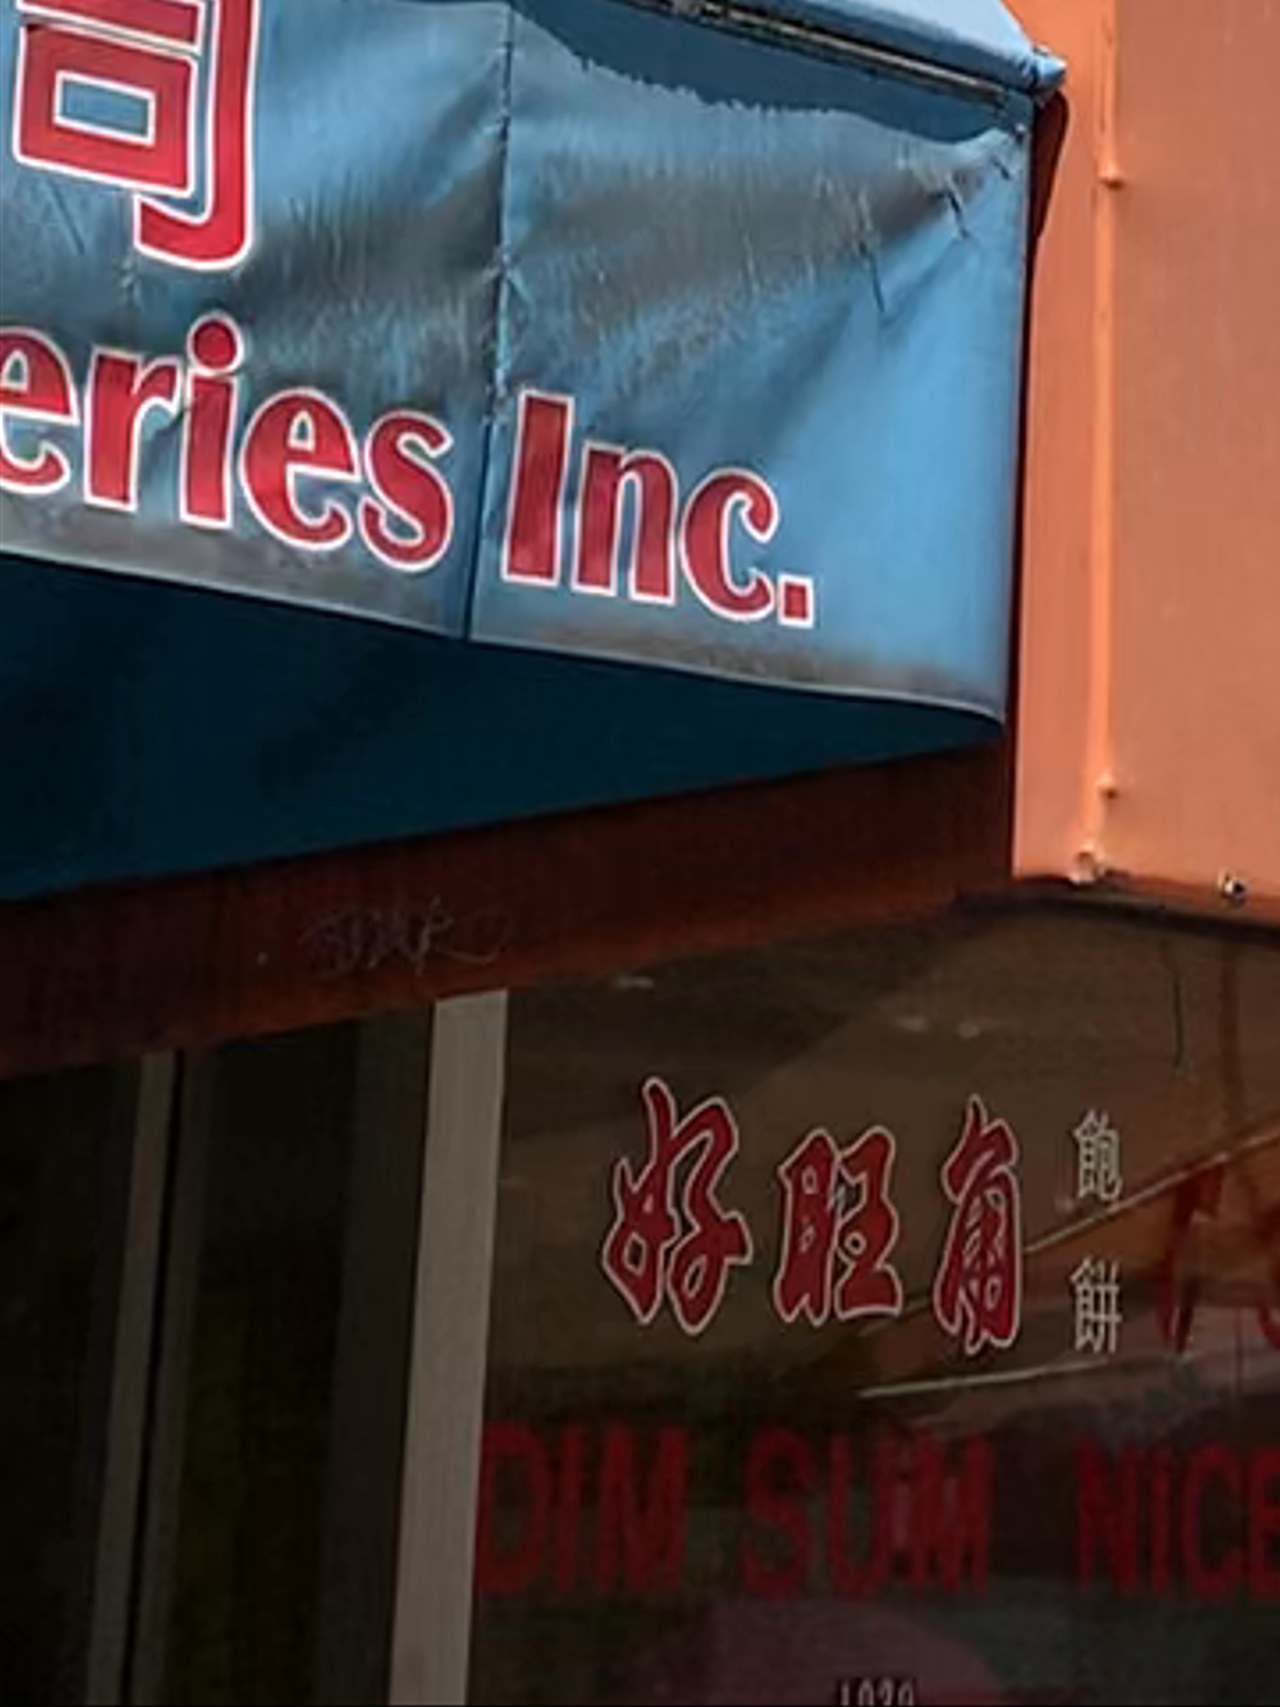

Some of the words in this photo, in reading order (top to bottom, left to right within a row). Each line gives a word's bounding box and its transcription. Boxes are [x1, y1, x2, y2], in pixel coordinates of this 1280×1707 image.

[501, 387, 815, 628] Inc.
[600, 1075, 1023, 1358] 好旺角
[475, 1420, 690, 1597] DIM
[738, 1429, 994, 1600] SUM
